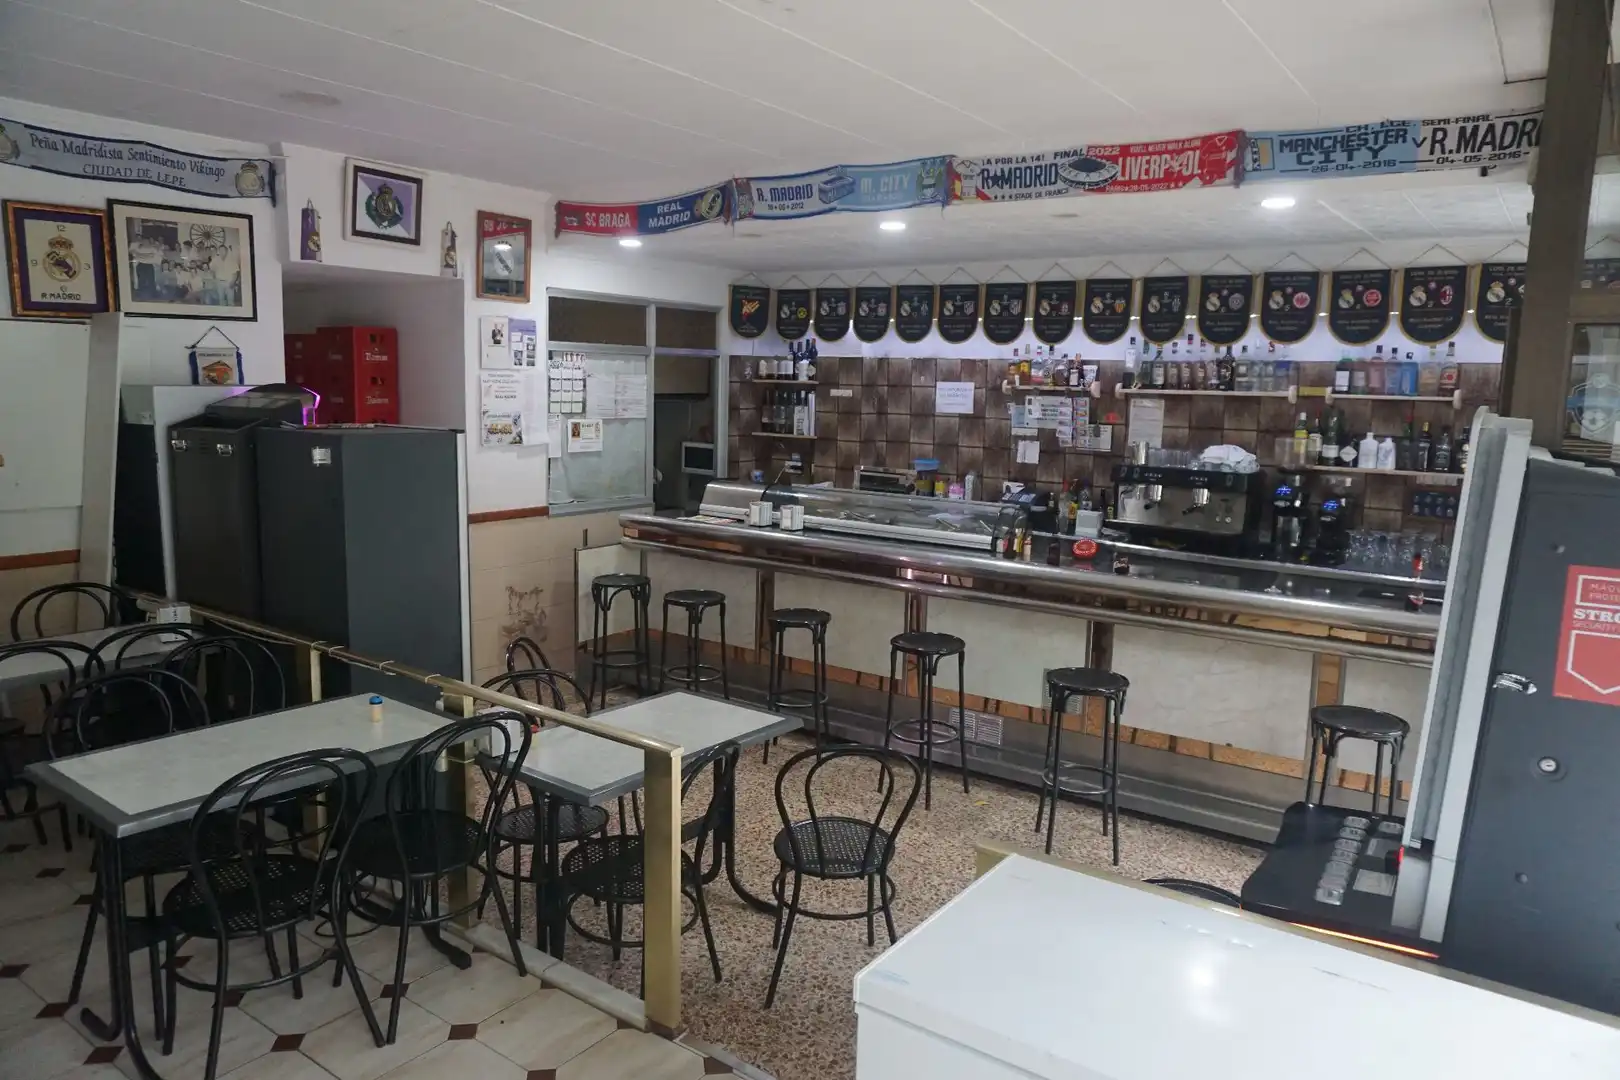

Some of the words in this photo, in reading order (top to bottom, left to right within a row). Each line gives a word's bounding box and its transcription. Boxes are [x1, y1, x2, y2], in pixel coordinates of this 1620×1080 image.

[1422, 114, 1494, 126] SEMI-FINAL
[1279, 128, 1408, 153] MANCHESTER
[30, 133, 59, 151] Peña
[61, 139, 124, 161] Madridista
[127, 148, 187, 171] Sentimiento
[189, 160, 225, 183] Vikingo
[995, 156, 1013, 165] POR
[1015, 155, 1027, 164] LA
[1053, 148, 1085, 160] FINAL
[1088, 146, 1120, 156] 2022
[1296, 144, 1388, 166] CITY
[83, 163, 133, 178] CIUDAD
[136, 167, 152, 178] DE
[157, 172, 187, 187] LEPE
[880, 172, 911, 192] CITY
[770, 183, 814, 202] MADRID
[1014, 192, 1033, 201] STADE
[657, 202, 683, 214] REAL
[56, 224, 67, 232] 12
[585, 211, 597, 227] SC
[599, 212, 631, 228] BRAGA
[648, 211, 691, 229] MADRID
[30, 259, 38, 267] 9
